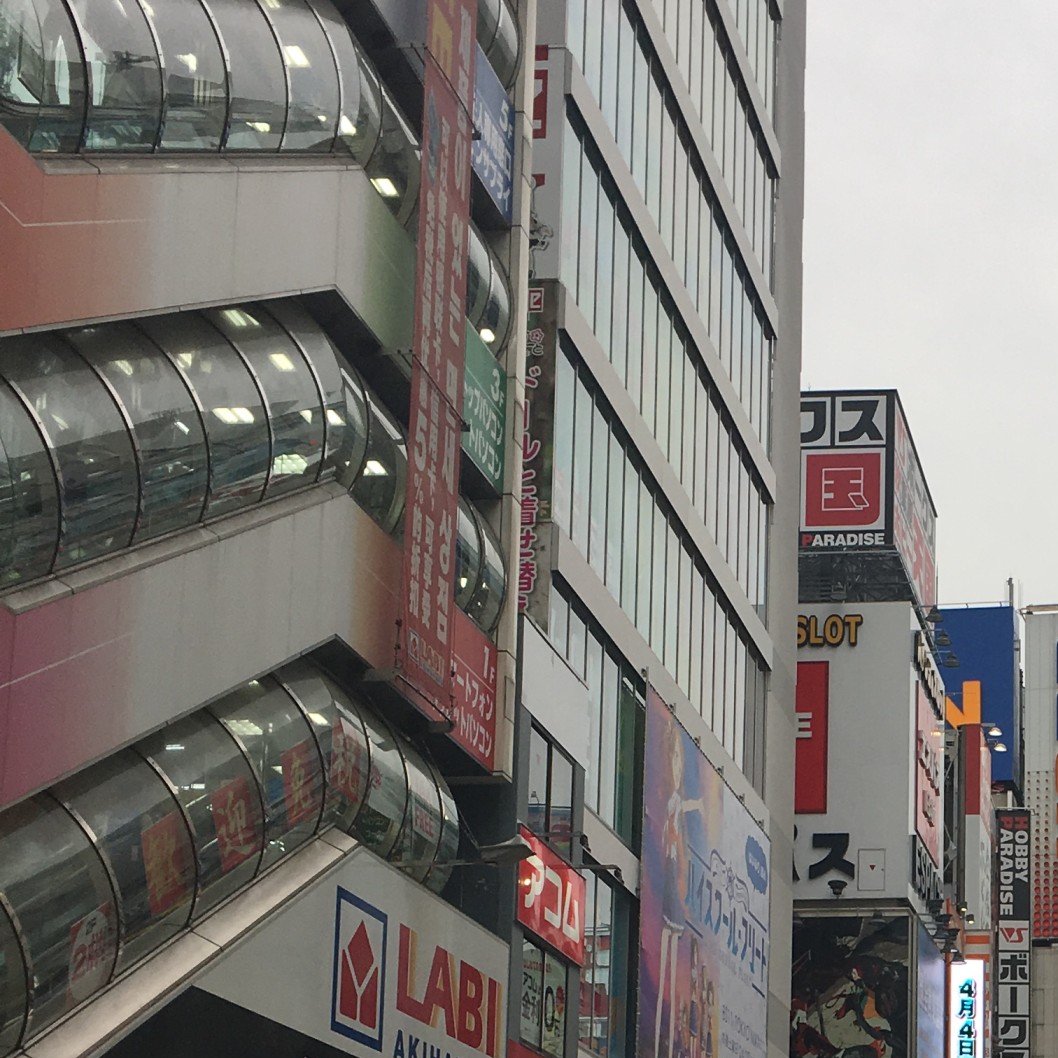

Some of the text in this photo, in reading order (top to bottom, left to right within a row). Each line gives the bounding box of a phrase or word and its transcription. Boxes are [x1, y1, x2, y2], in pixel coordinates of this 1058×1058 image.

[801, 532, 885, 547] PARADISE
[797, 615, 863, 647] SLOT
[1000, 816, 1014, 916] PARADISE
[1015, 816, 1029, 883] HOBBY
[518, 834, 579, 944] アコム
